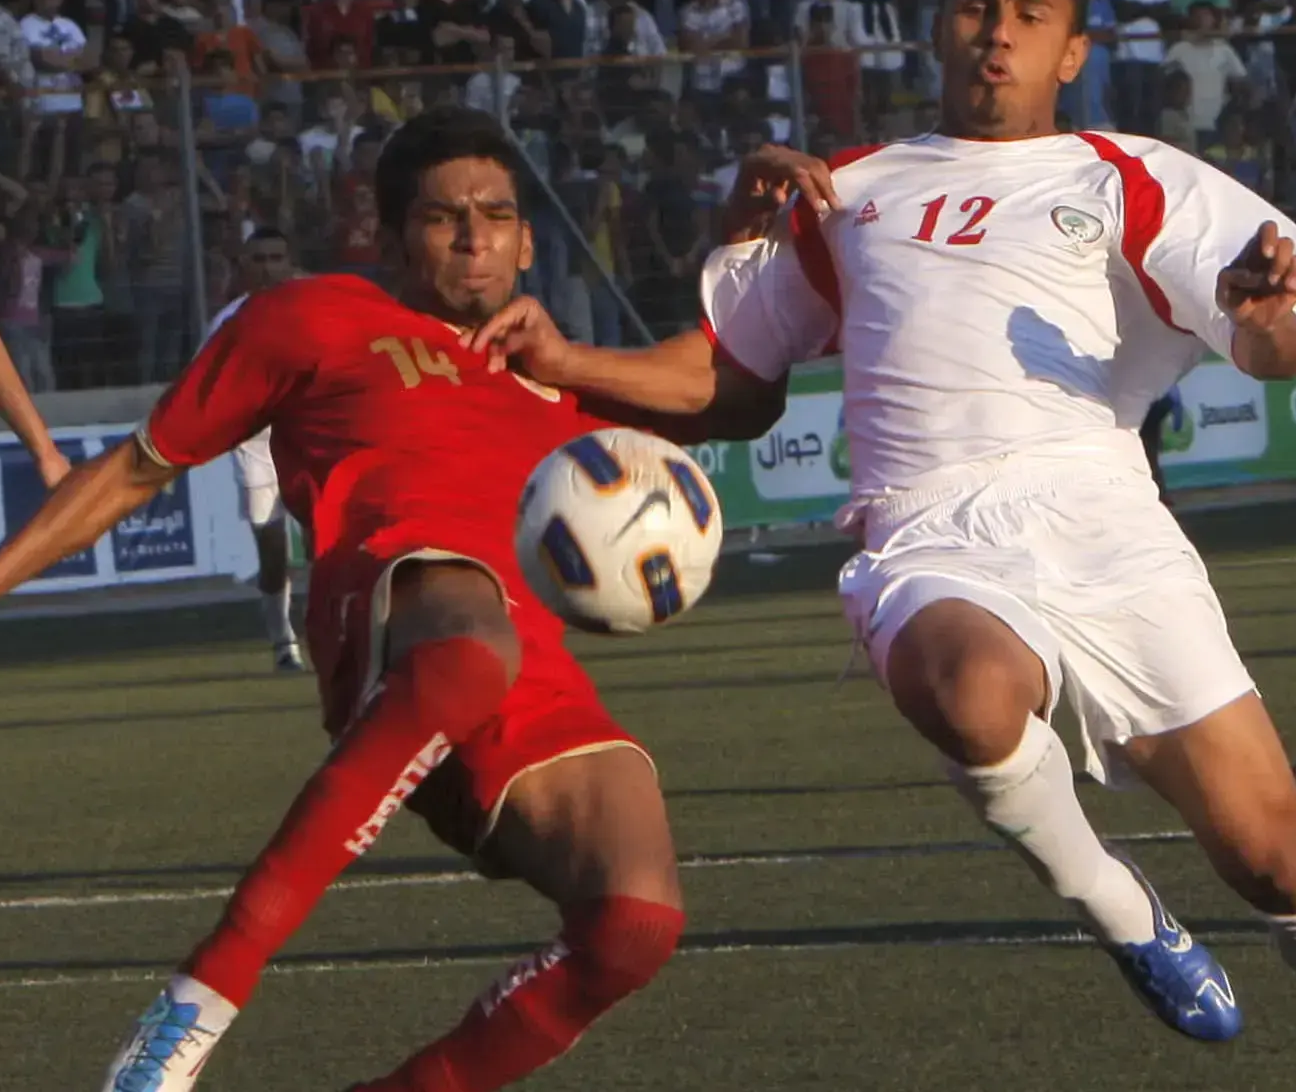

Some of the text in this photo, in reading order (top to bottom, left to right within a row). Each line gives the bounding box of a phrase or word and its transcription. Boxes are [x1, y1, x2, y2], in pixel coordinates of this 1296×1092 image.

[911, 193, 999, 245] 12
[369, 336, 463, 389] 14
[755, 431, 823, 470] جوال
